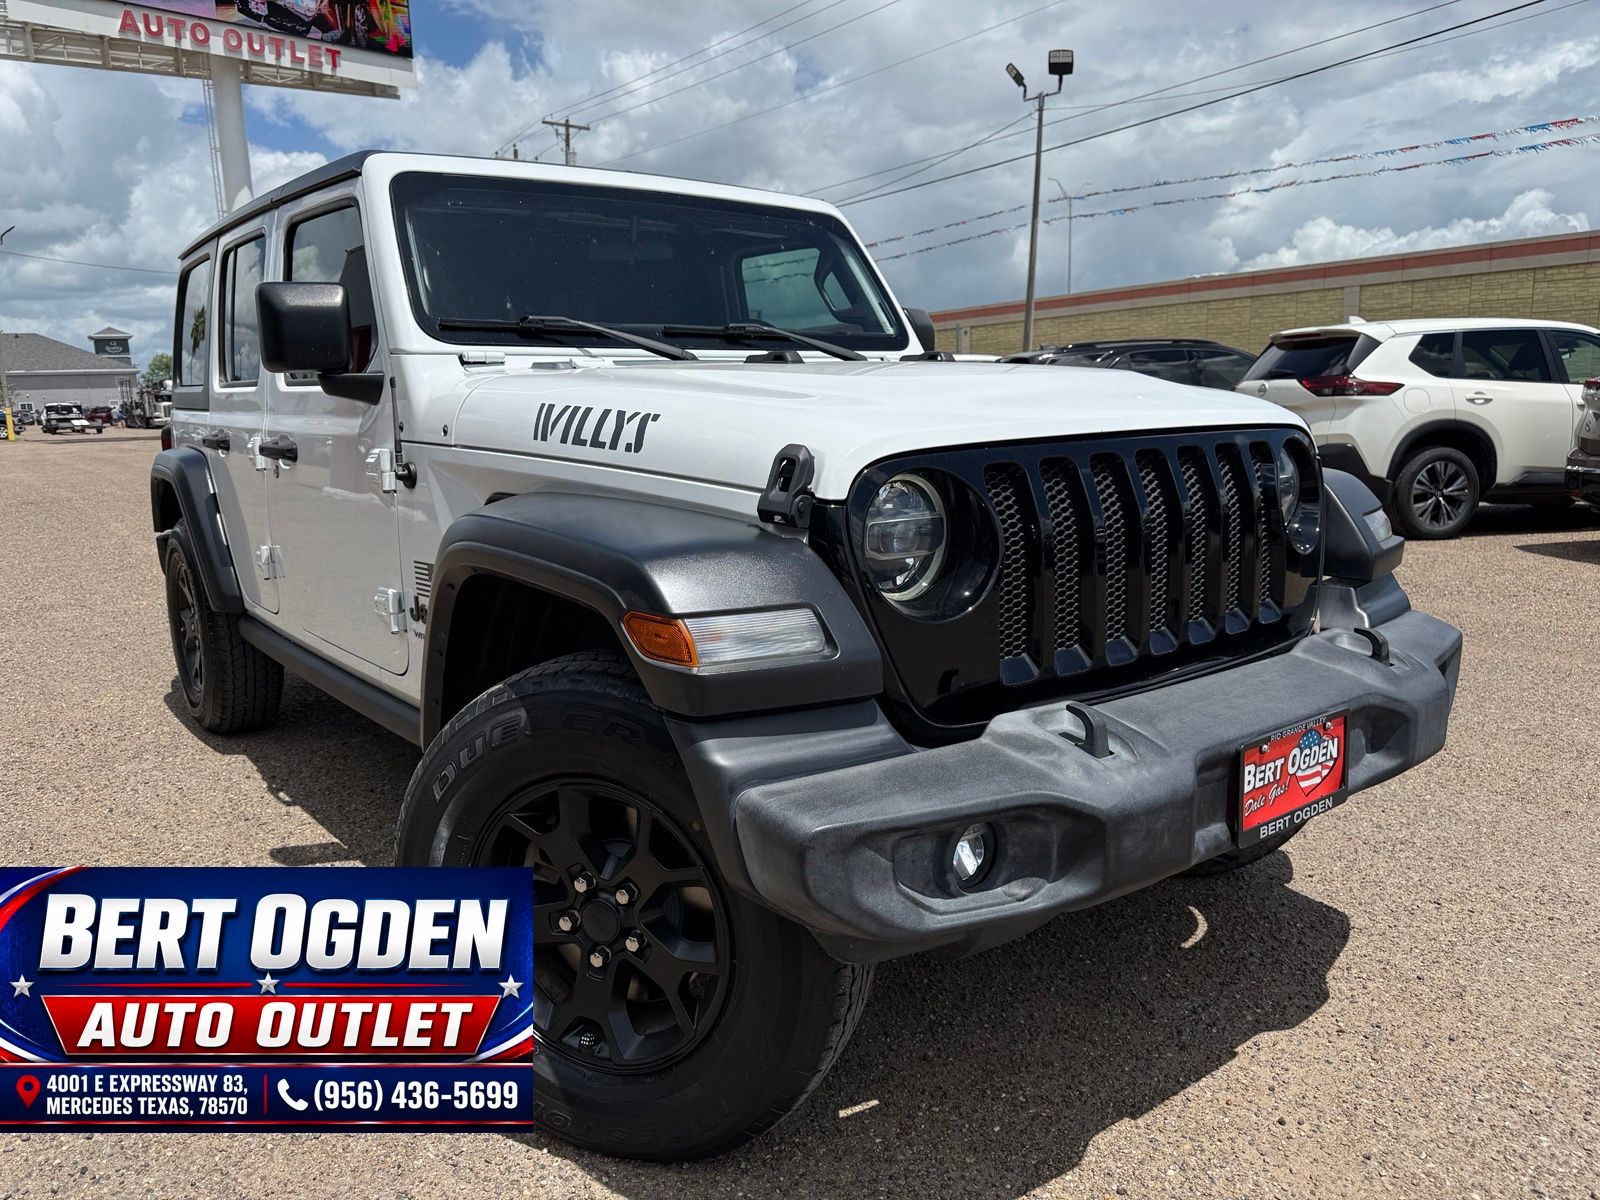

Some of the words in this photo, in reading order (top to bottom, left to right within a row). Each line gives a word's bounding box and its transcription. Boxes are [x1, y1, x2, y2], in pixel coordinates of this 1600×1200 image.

[119, 9, 210, 46] AUTO
[223, 27, 341, 69] OUTLET
[533, 402, 661, 454] WILLYS
[1270, 733, 1281, 743] RIO
[1281, 726, 1306, 739] GRANDE
[1306, 717, 1327, 730] VALLEY
[1244, 757, 1285, 794] BERT
[1287, 738, 1338, 775] OGDEN
[1244, 795, 1266, 816] Dale
[1269, 776, 1291, 806] Gas!
[1259, 814, 1291, 839] BERT
[1293, 796, 1333, 824] OGDEN
